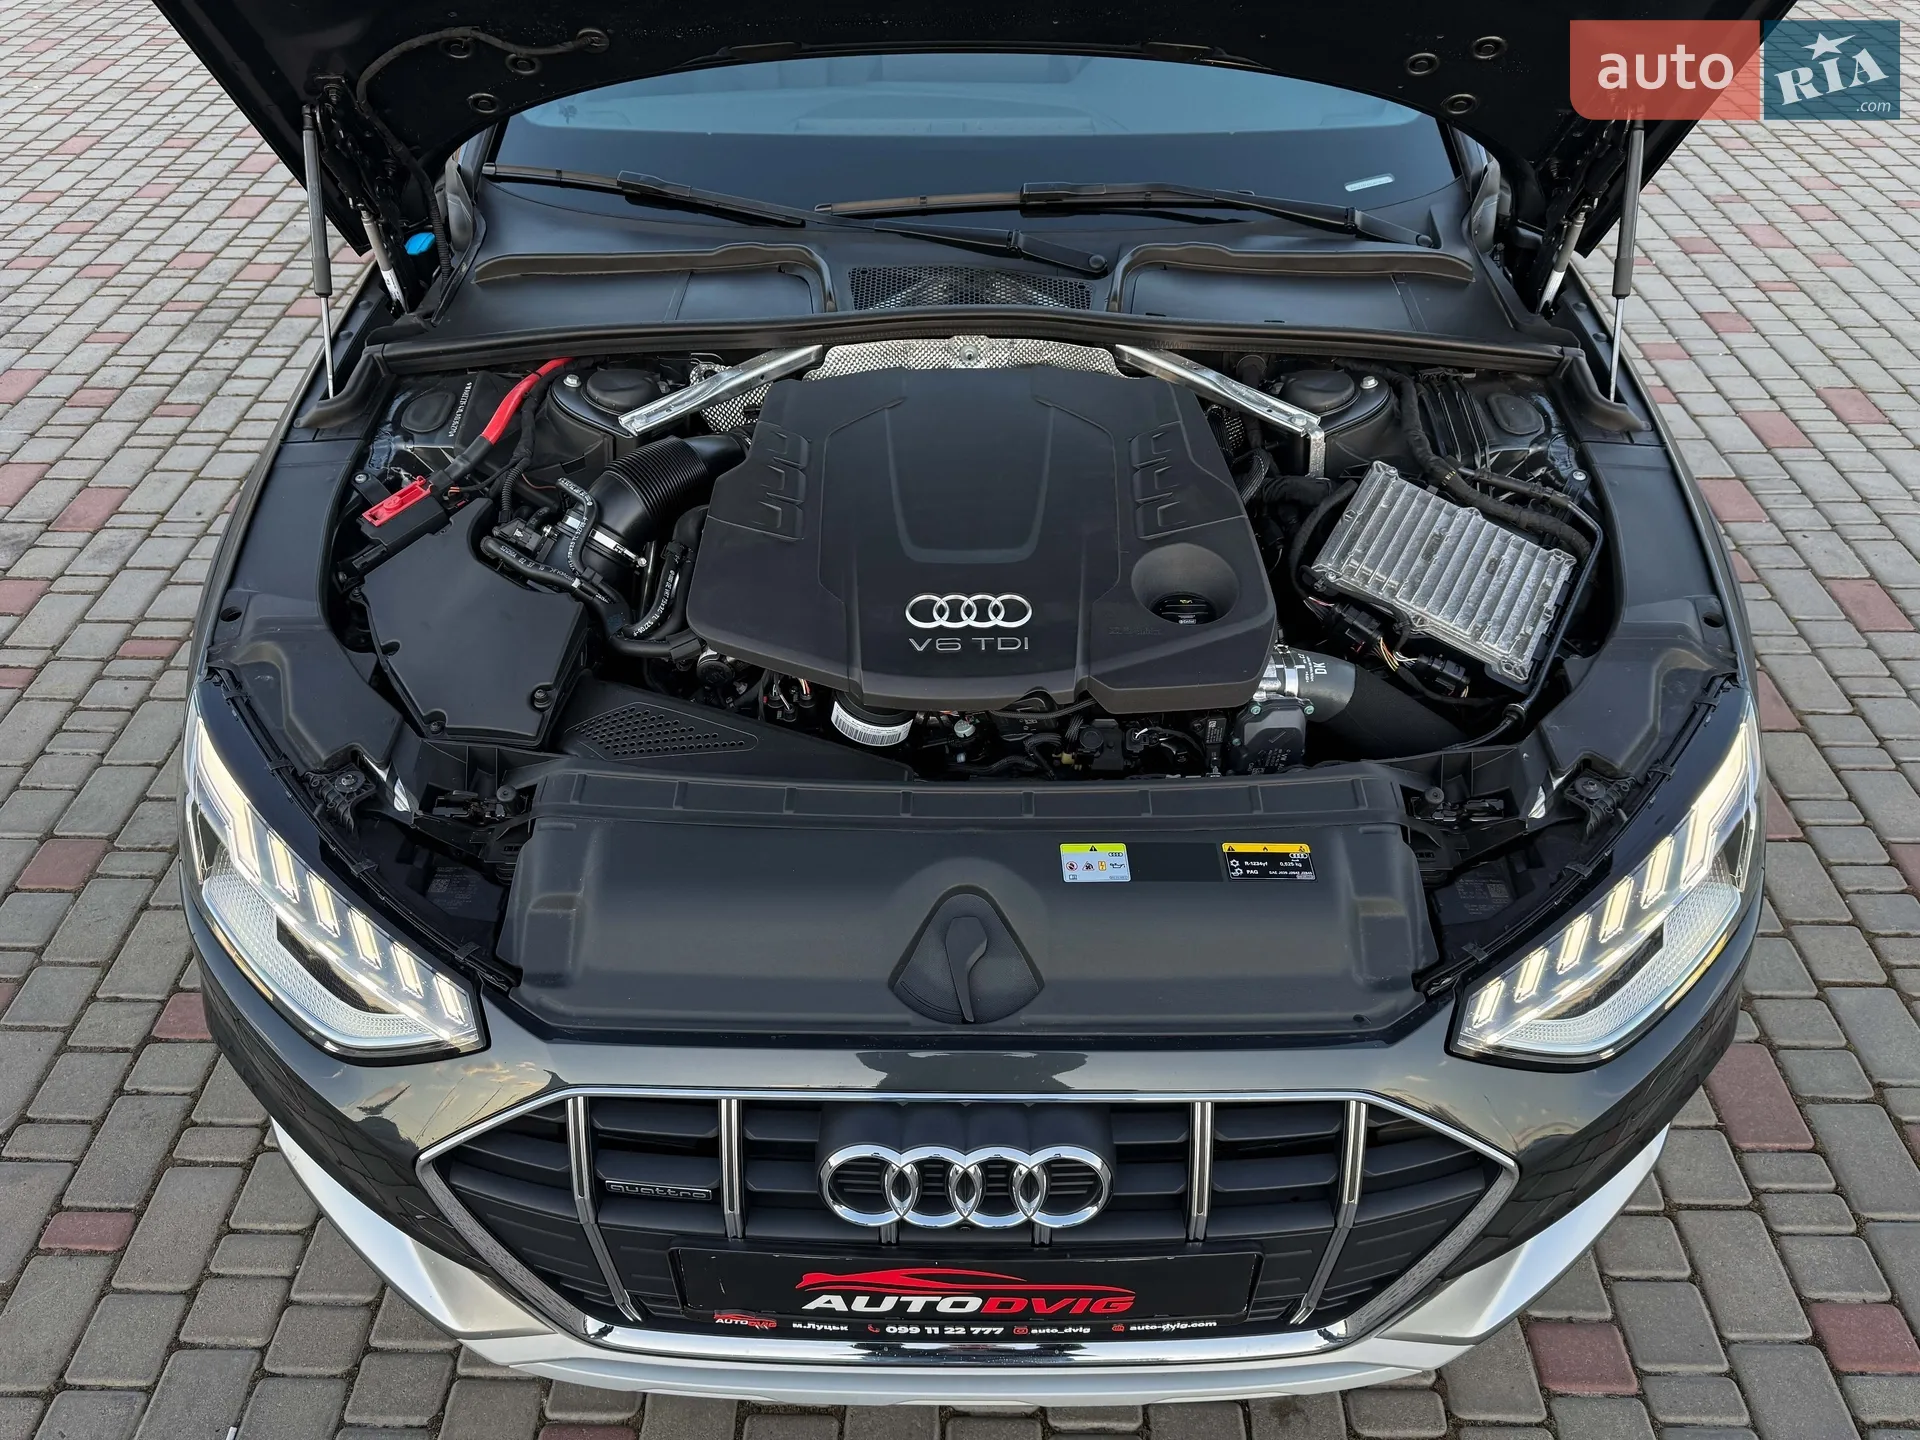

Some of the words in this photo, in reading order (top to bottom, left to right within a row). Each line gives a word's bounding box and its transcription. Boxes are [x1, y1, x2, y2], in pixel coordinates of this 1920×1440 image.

[908, 637, 962, 651] V6
[971, 636, 1029, 651] TDI
[1313, 662, 1328, 675] DK
[610, 1184, 707, 1199] quattro
[802, 1294, 1136, 1314] AUTODVIG
[792, 1322, 849, 1331] м.Луцьк
[885, 1325, 921, 1334] 099
[925, 1326, 940, 1334] 11
[944, 1326, 967, 1335] 22
[970, 1327, 1004, 1335] 777
[1031, 1327, 1091, 1335] auto_dvig
[1129, 1321, 1217, 1333] auto-dvig.com
